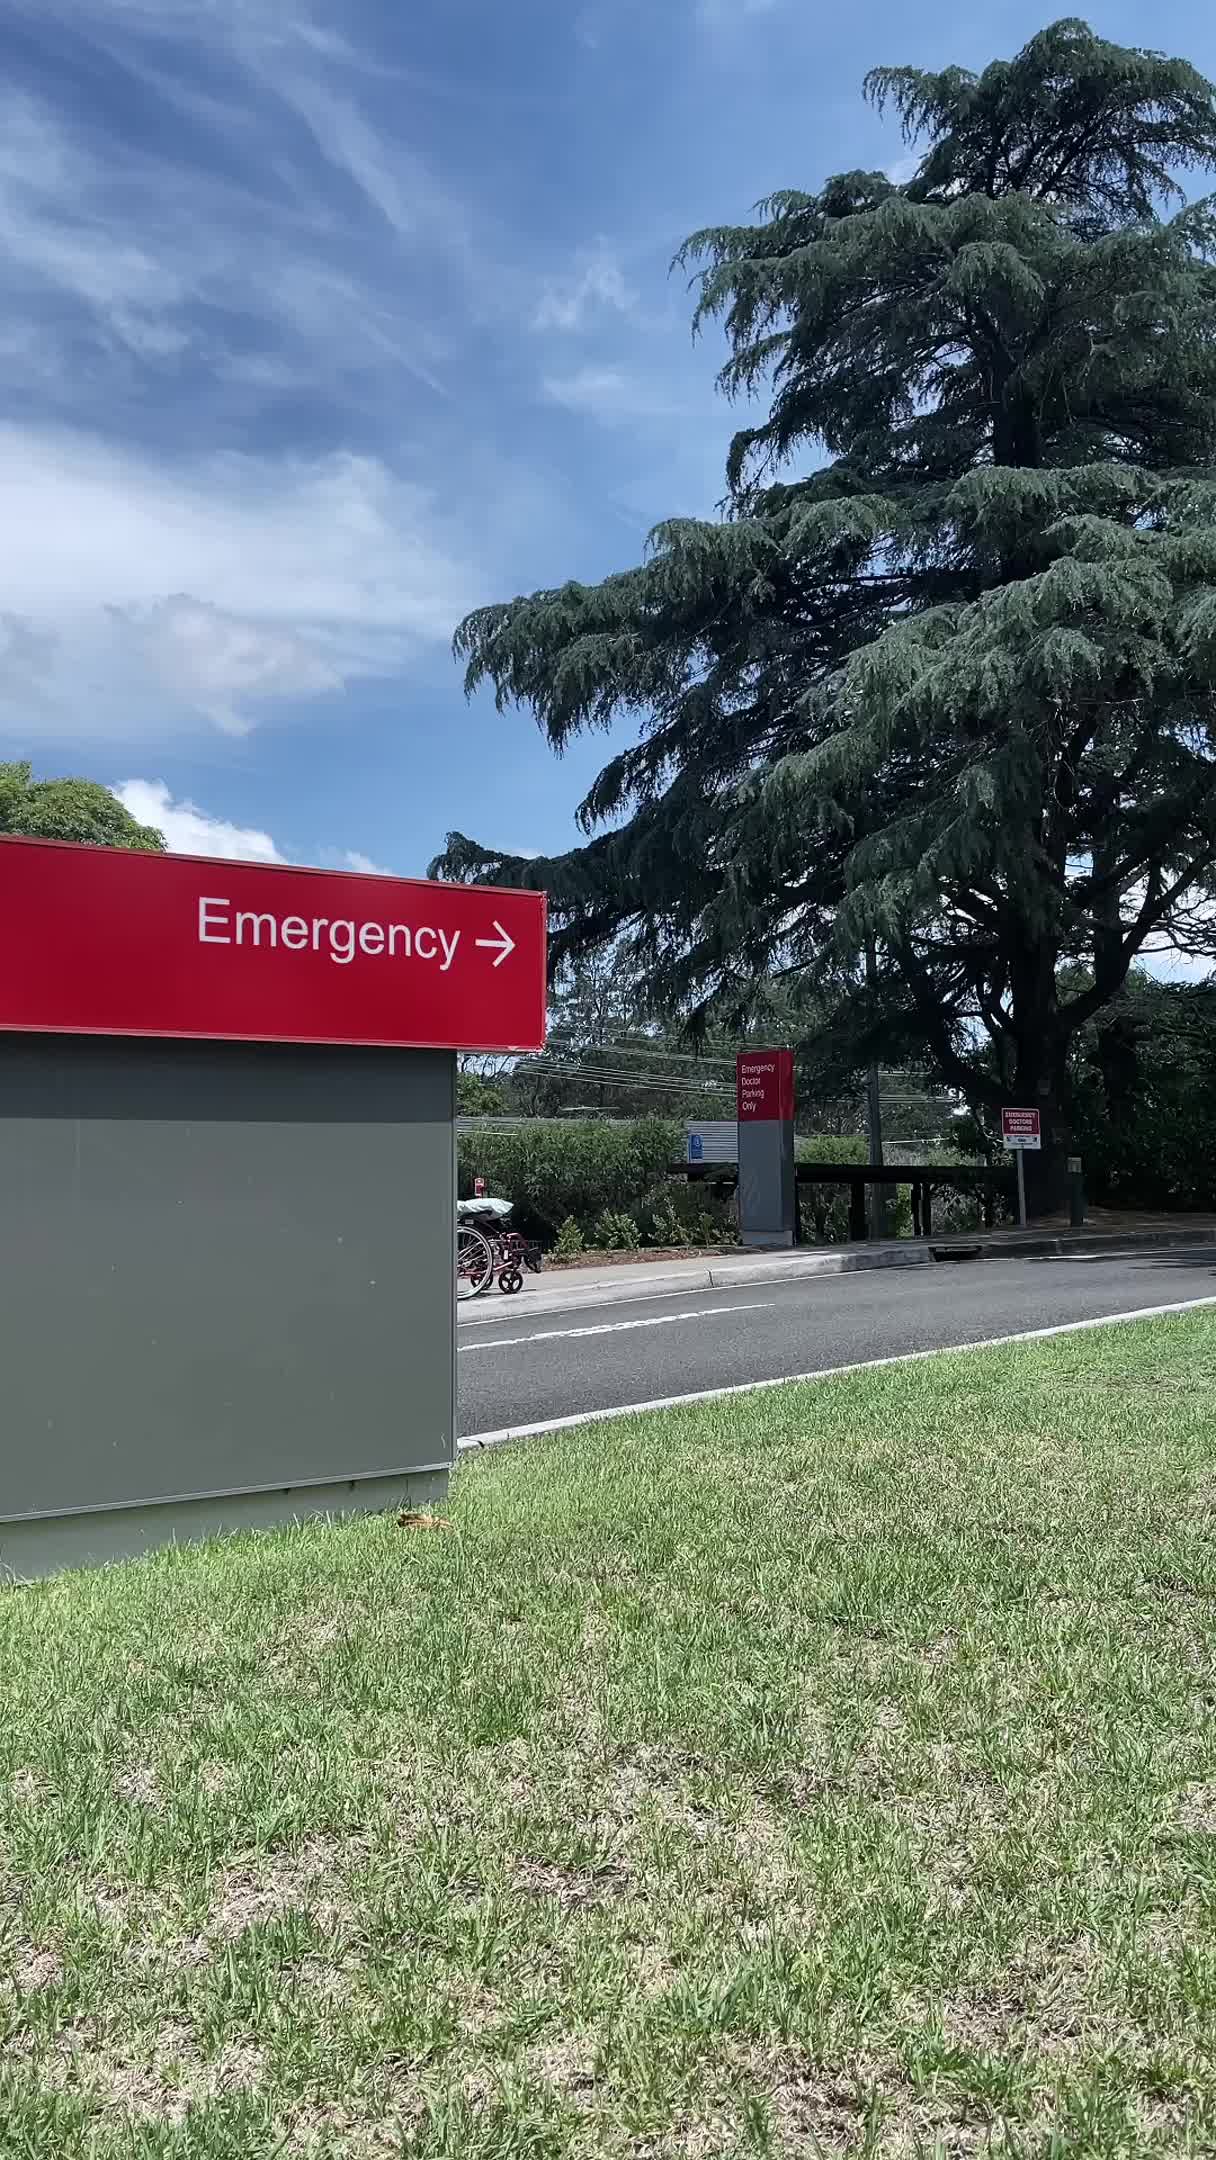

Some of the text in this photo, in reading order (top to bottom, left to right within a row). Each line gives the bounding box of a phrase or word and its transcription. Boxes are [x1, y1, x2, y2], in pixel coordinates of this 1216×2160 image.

[199, 897, 461, 971] Emergency
[741, 1064, 775, 1074] Emergency
[741, 1077, 761, 1086] Doctor
[742, 1089, 764, 1098] Parking
[742, 1101, 757, 1112] Only
